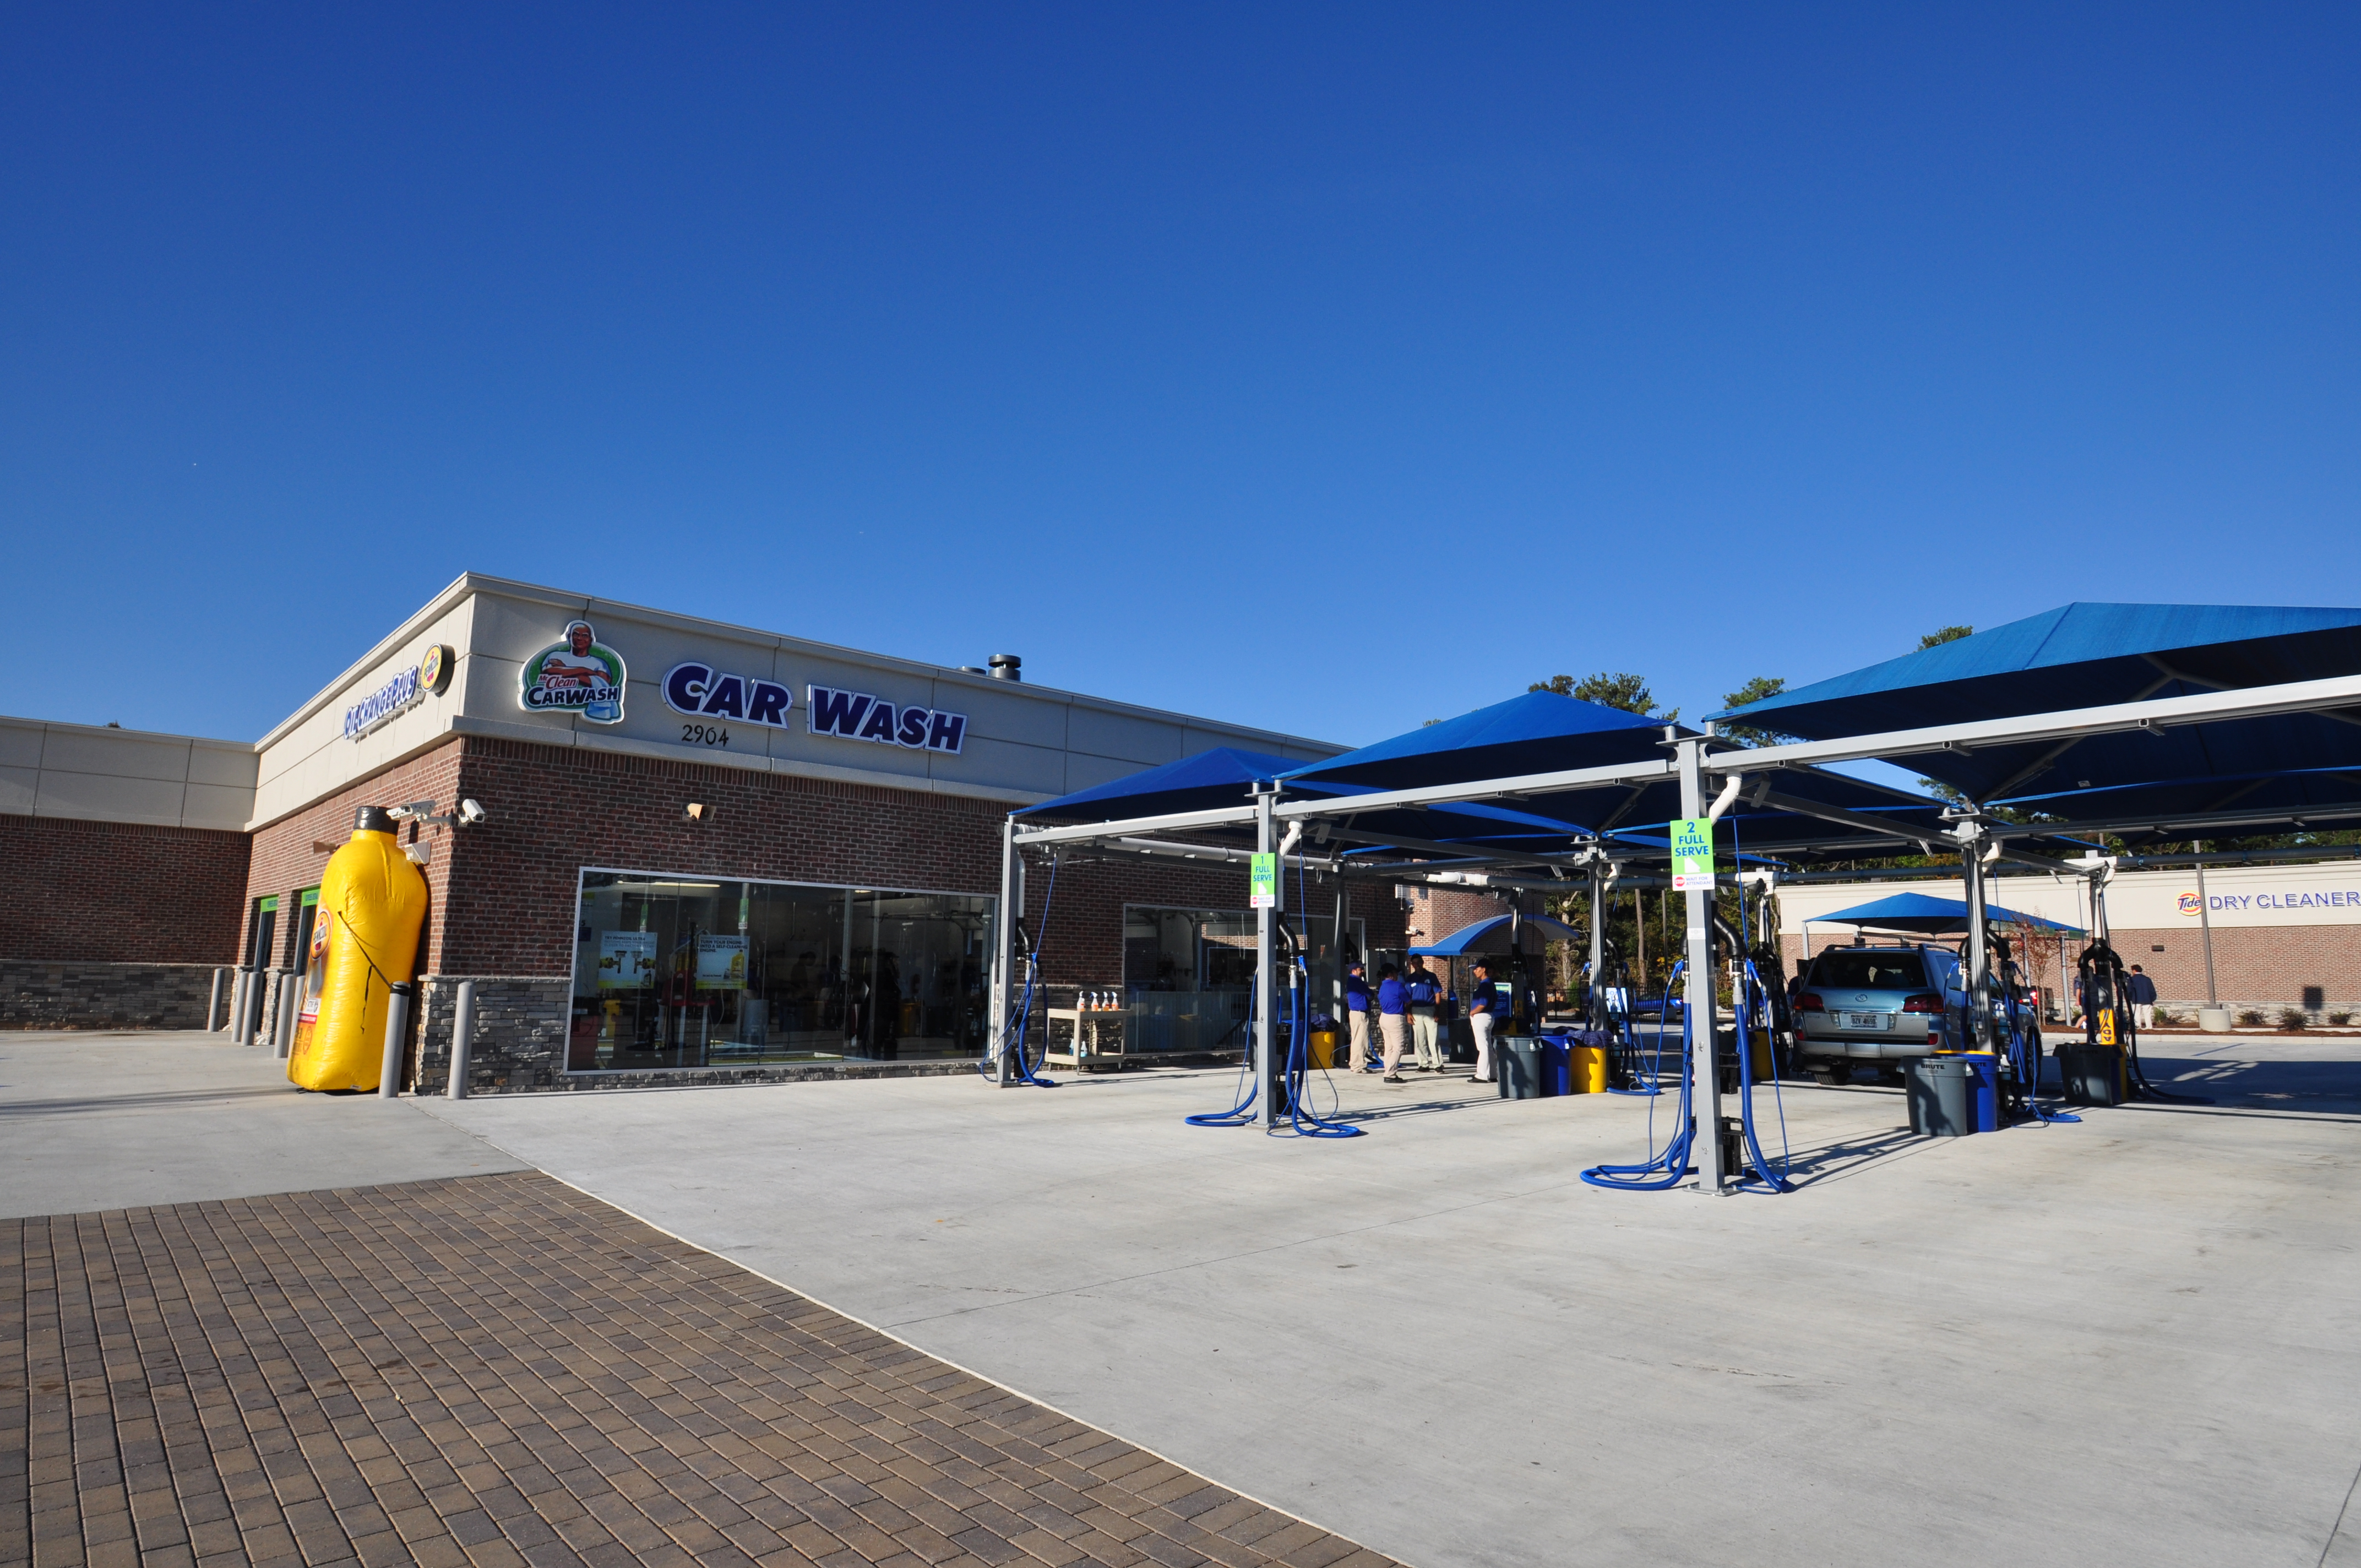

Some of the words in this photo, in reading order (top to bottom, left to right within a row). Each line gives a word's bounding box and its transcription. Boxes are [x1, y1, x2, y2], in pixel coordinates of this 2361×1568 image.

[546, 677, 577, 689] Clean
[344, 706, 360, 739] OIL
[358, 682, 394, 731] CHANGE
[390, 665, 417, 709] PLUS
[664, 662, 793, 729] CAR
[807, 684, 968, 754] WASH
[682, 725, 729, 747] 2904
[1687, 821, 1695, 833] 2
[1679, 834, 1705, 845] FULL
[1675, 846, 1709, 857] SERVE
[1261, 855, 1264, 864] 1
[2177, 897, 2201, 910] Tide
[2210, 895, 2252, 910] DRY
[2256, 891, 2361, 908] CLEANER
